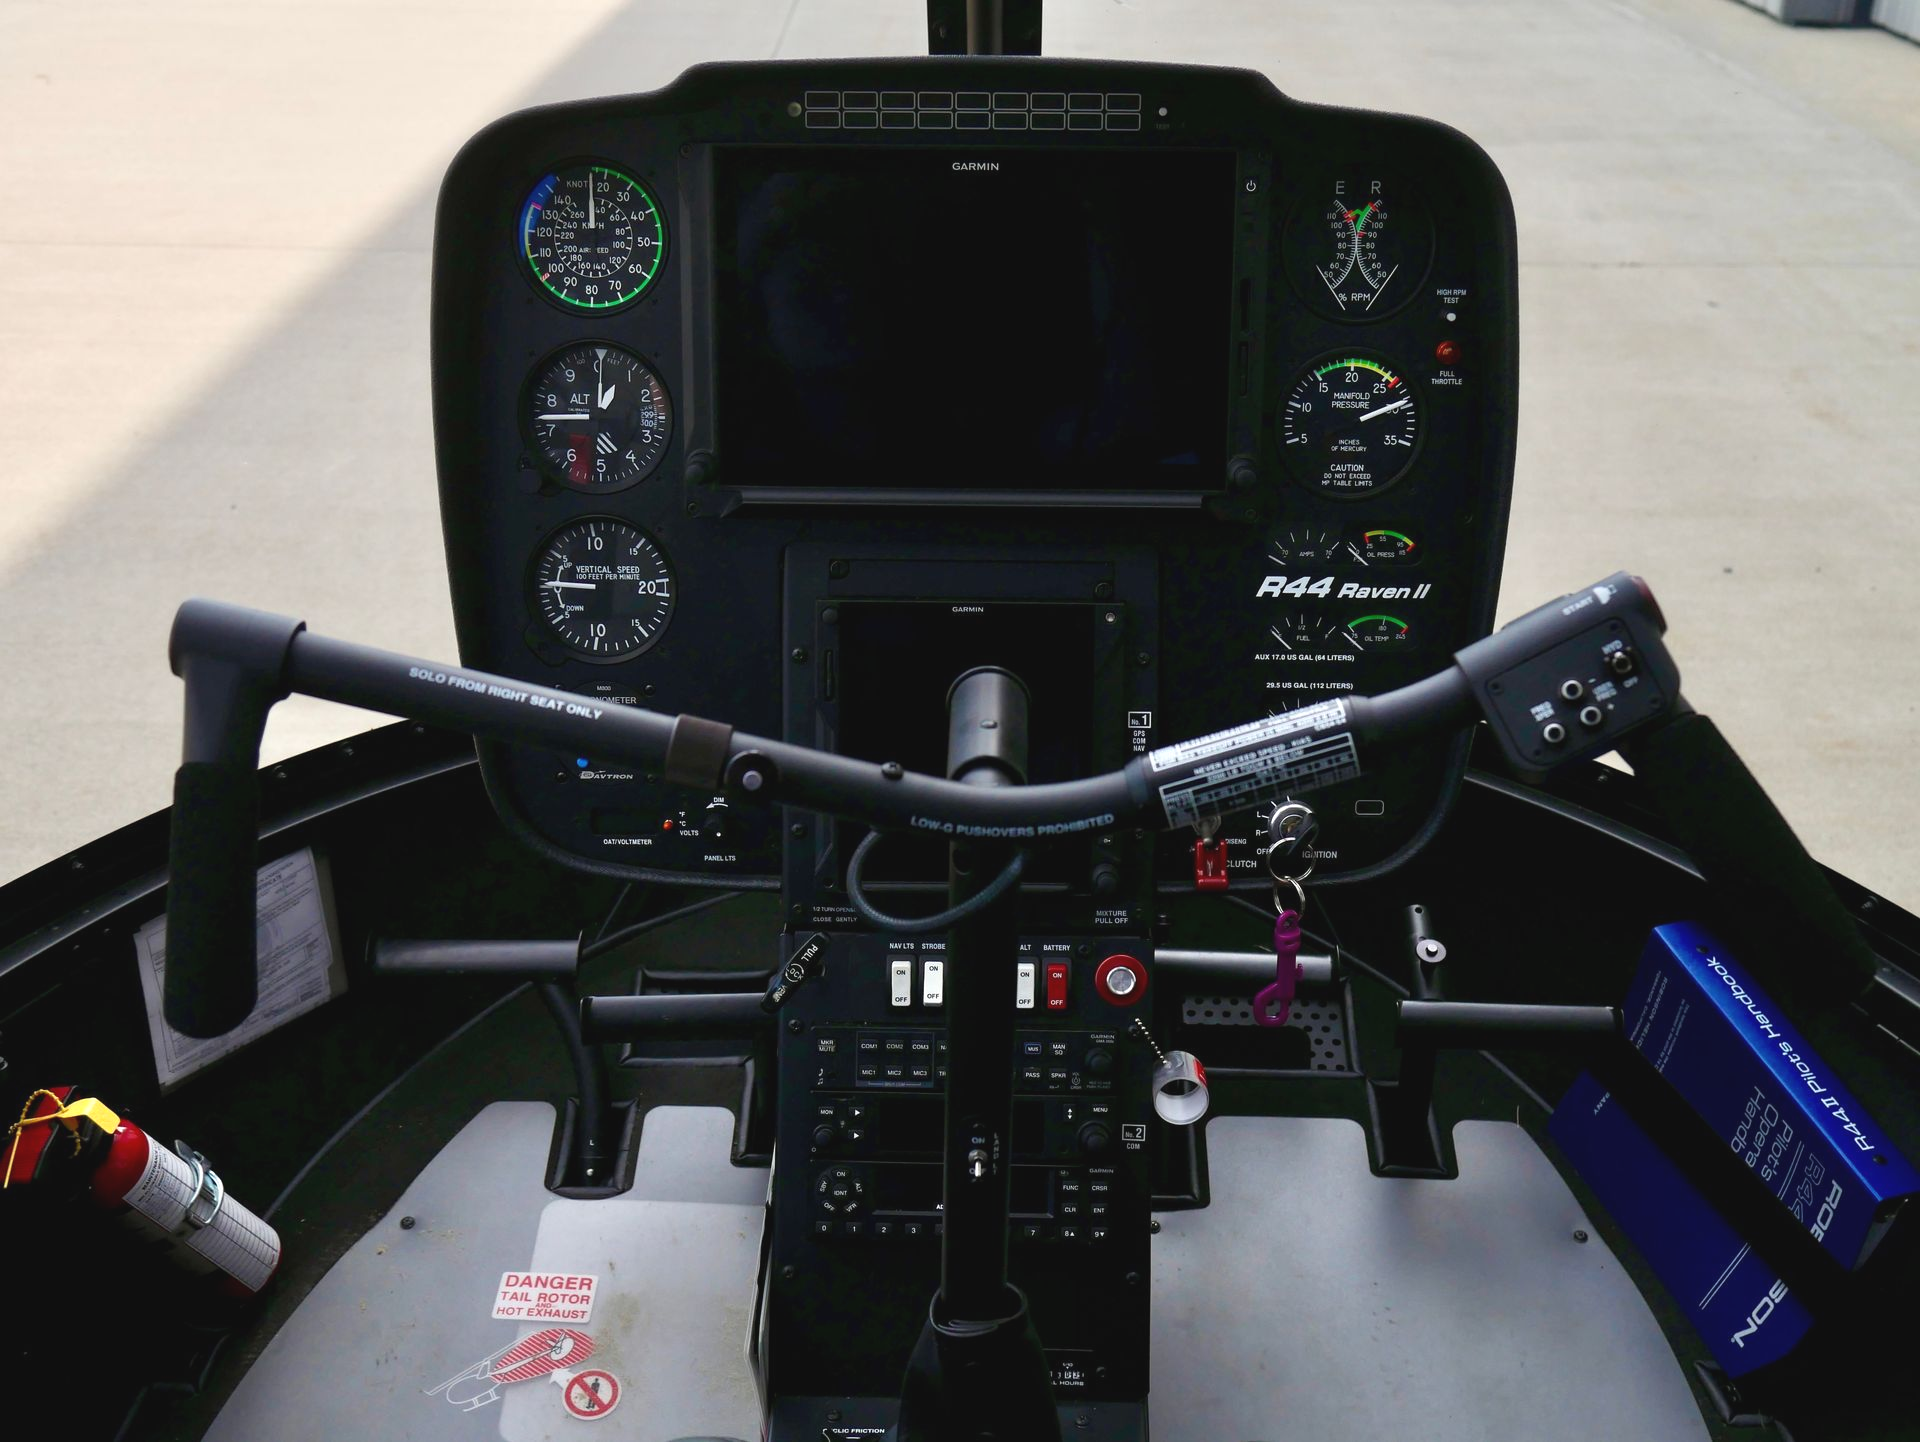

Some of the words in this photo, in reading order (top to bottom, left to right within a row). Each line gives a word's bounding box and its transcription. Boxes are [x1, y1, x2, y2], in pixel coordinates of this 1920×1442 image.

[951, 162, 1000, 172] GARMIN
[596, 183, 610, 192] 20
[1335, 181, 1345, 195] E
[1371, 181, 1381, 194] R
[554, 195, 571, 205] 140
[616, 192, 630, 202] 30
[542, 210, 558, 220] 130
[630, 211, 645, 221] 40
[536, 227, 552, 237] 120
[637, 237, 650, 247] 50
[539, 248, 551, 258] 110
[548, 263, 564, 273] 100
[628, 264, 642, 274] 60
[563, 277, 577, 287] 90
[608, 280, 622, 290] 70
[585, 285, 598, 295] 80
[1338, 293, 1347, 301] %
[1351, 293, 1371, 301] RPM
[565, 369, 575, 382] 9
[1345, 373, 1359, 383] 20
[1318, 383, 1329, 393] 15
[1373, 384, 1386, 394] 25
[547, 394, 557, 408] 8
[570, 393, 590, 405] ALT
[641, 389, 651, 403] 2
[1334, 392, 1370, 400] MANIFOLD
[1302, 403, 1312, 413] 10
[1331, 401, 1370, 409] PRESSURE
[546, 424, 555, 437] 7
[642, 429, 651, 443] 3
[1383, 435, 1397, 445] 35
[567, 449, 577, 462] 6
[625, 450, 636, 463] 4
[596, 459, 606, 472] 5
[1330, 464, 1364, 472] CAUTION
[587, 537, 603, 551] 10
[629, 548, 638, 556] 15
[576, 566, 611, 574] VERTICAL
[617, 565, 640, 574] SPEED
[638, 581, 656, 594] 20
[1255, 576, 1335, 598] R44
[1337, 583, 1411, 599] Raven
[1562, 596, 1594, 616] START
[590, 623, 606, 637] 10
[1326, 654, 1355, 662] LITERS)
[1310, 682, 1325, 690] (112
[1325, 682, 1354, 690] LITERS)
[409, 667, 445, 684] SOLO
[448, 678, 486, 694] FROM
[487, 685, 528, 702] RIGHT
[529, 694, 564, 711] SEAT
[566, 703, 603, 720] ONLY
[1141, 714, 1148, 725] 1
[910, 815, 953, 833] LOW-G
[956, 824, 1035, 837] PUSHOVERS
[1037, 814, 1114, 836] PROHIBITED
[1302, 851, 1338, 859] IGNITION
[801, 944, 819, 961] PULL
[1706, 956, 1781, 1039] Handbook
[1778, 1041, 1827, 1094] Pilot's
[1730, 1086, 1765, 1153] Handb
[1136, 1128, 1142, 1138] 2
[1745, 1104, 1779, 1168] Opera
[1761, 1119, 1794, 1181] Pilot's
[855, 1182, 863, 1192] ALT
[823, 1202, 835, 1211] OFF
[505, 1274, 593, 1290] DANGER
[501, 1291, 532, 1302] TAIL
[537, 1292, 591, 1305] ROTOR
[496, 1307, 524, 1316] HOT
[527, 1308, 588, 1319] EXHAUST
